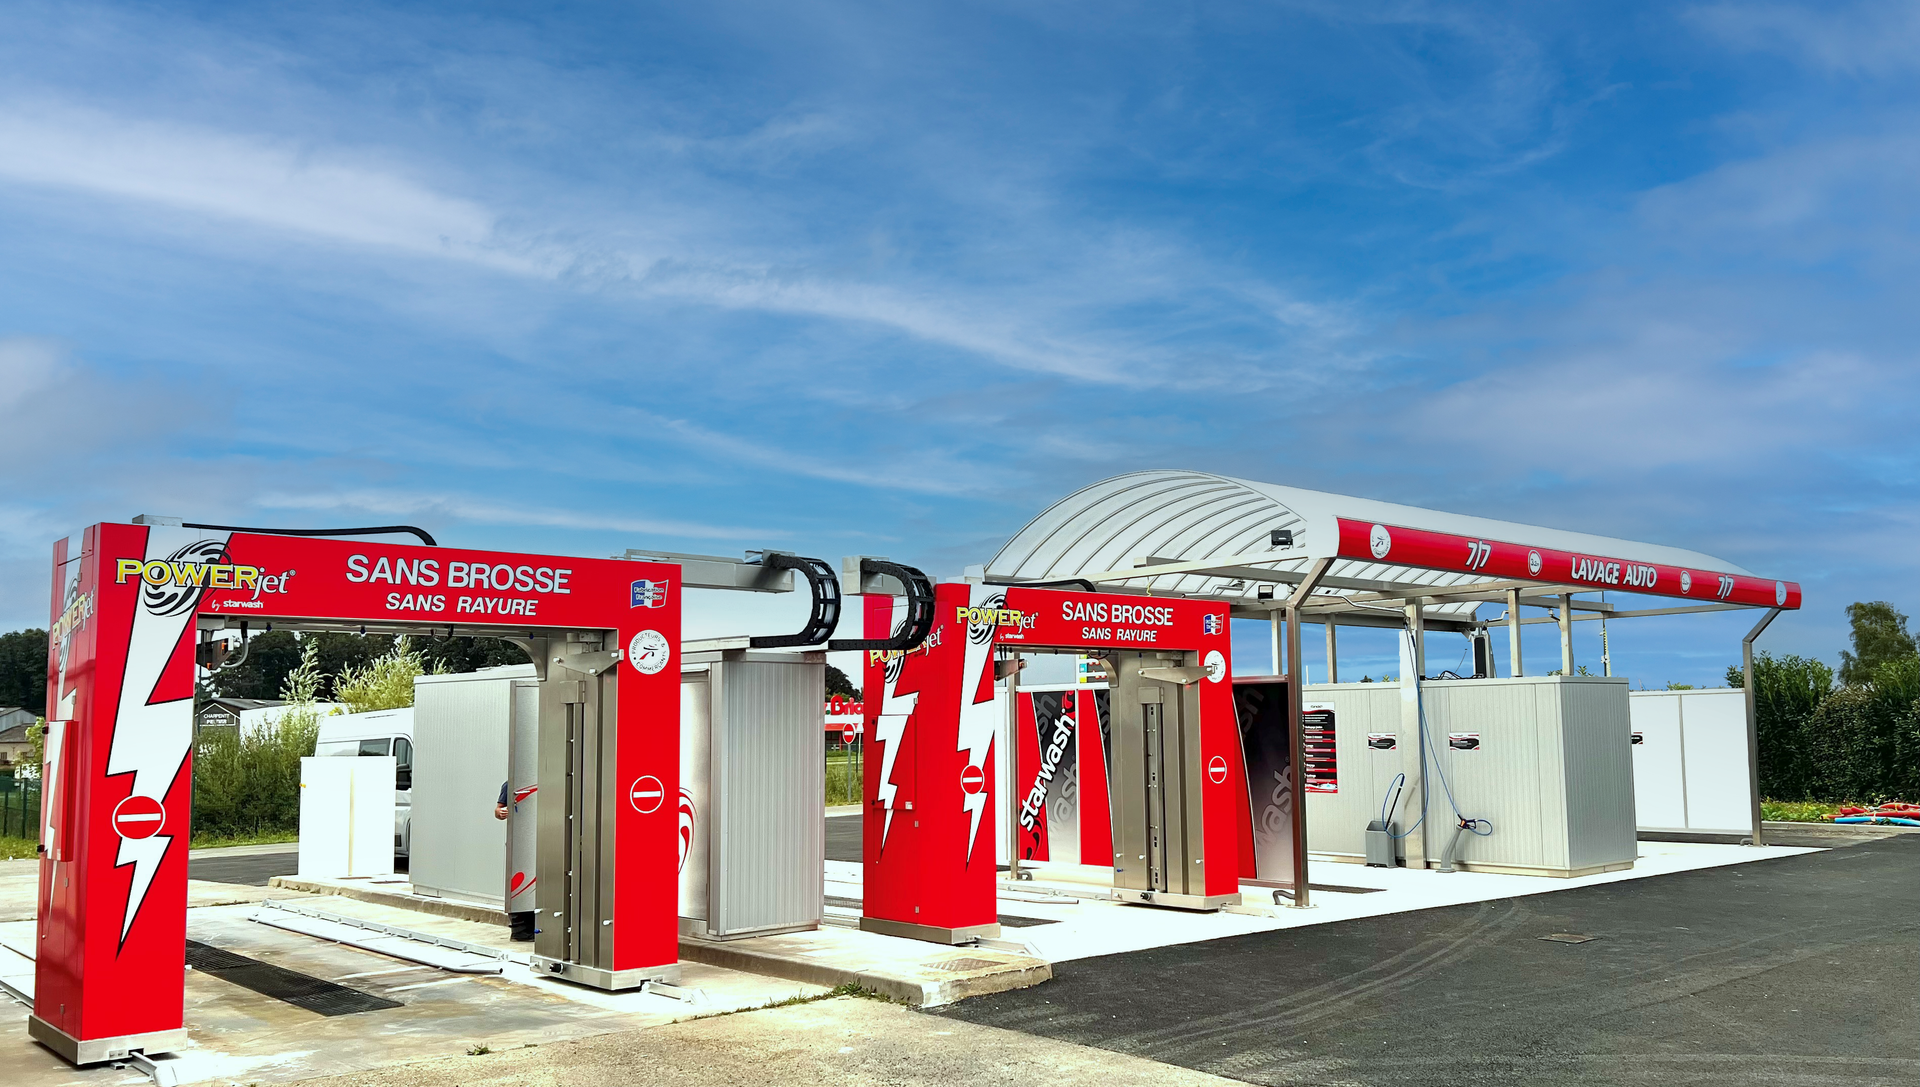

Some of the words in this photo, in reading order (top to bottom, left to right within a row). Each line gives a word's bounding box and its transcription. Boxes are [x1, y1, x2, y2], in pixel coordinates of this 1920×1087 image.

[1465, 539, 1492, 571] 7/7
[345, 554, 440, 587] SANS
[447, 561, 572, 594] BROSSE
[1571, 556, 1620, 585] LAVAGE
[1623, 563, 1657, 588] AUTO
[1716, 574, 1734, 600] 7/7
[211, 599, 221, 611] by
[223, 599, 264, 609] starwash
[385, 592, 446, 612] SANS
[456, 596, 539, 616] RAYURE
[1062, 600, 1108, 622] SANS
[1111, 604, 1174, 626] BROSSE
[1081, 626, 1112, 640] SANS
[1116, 628, 1157, 642] RAYURE
[1020, 712, 1075, 832] starwash
